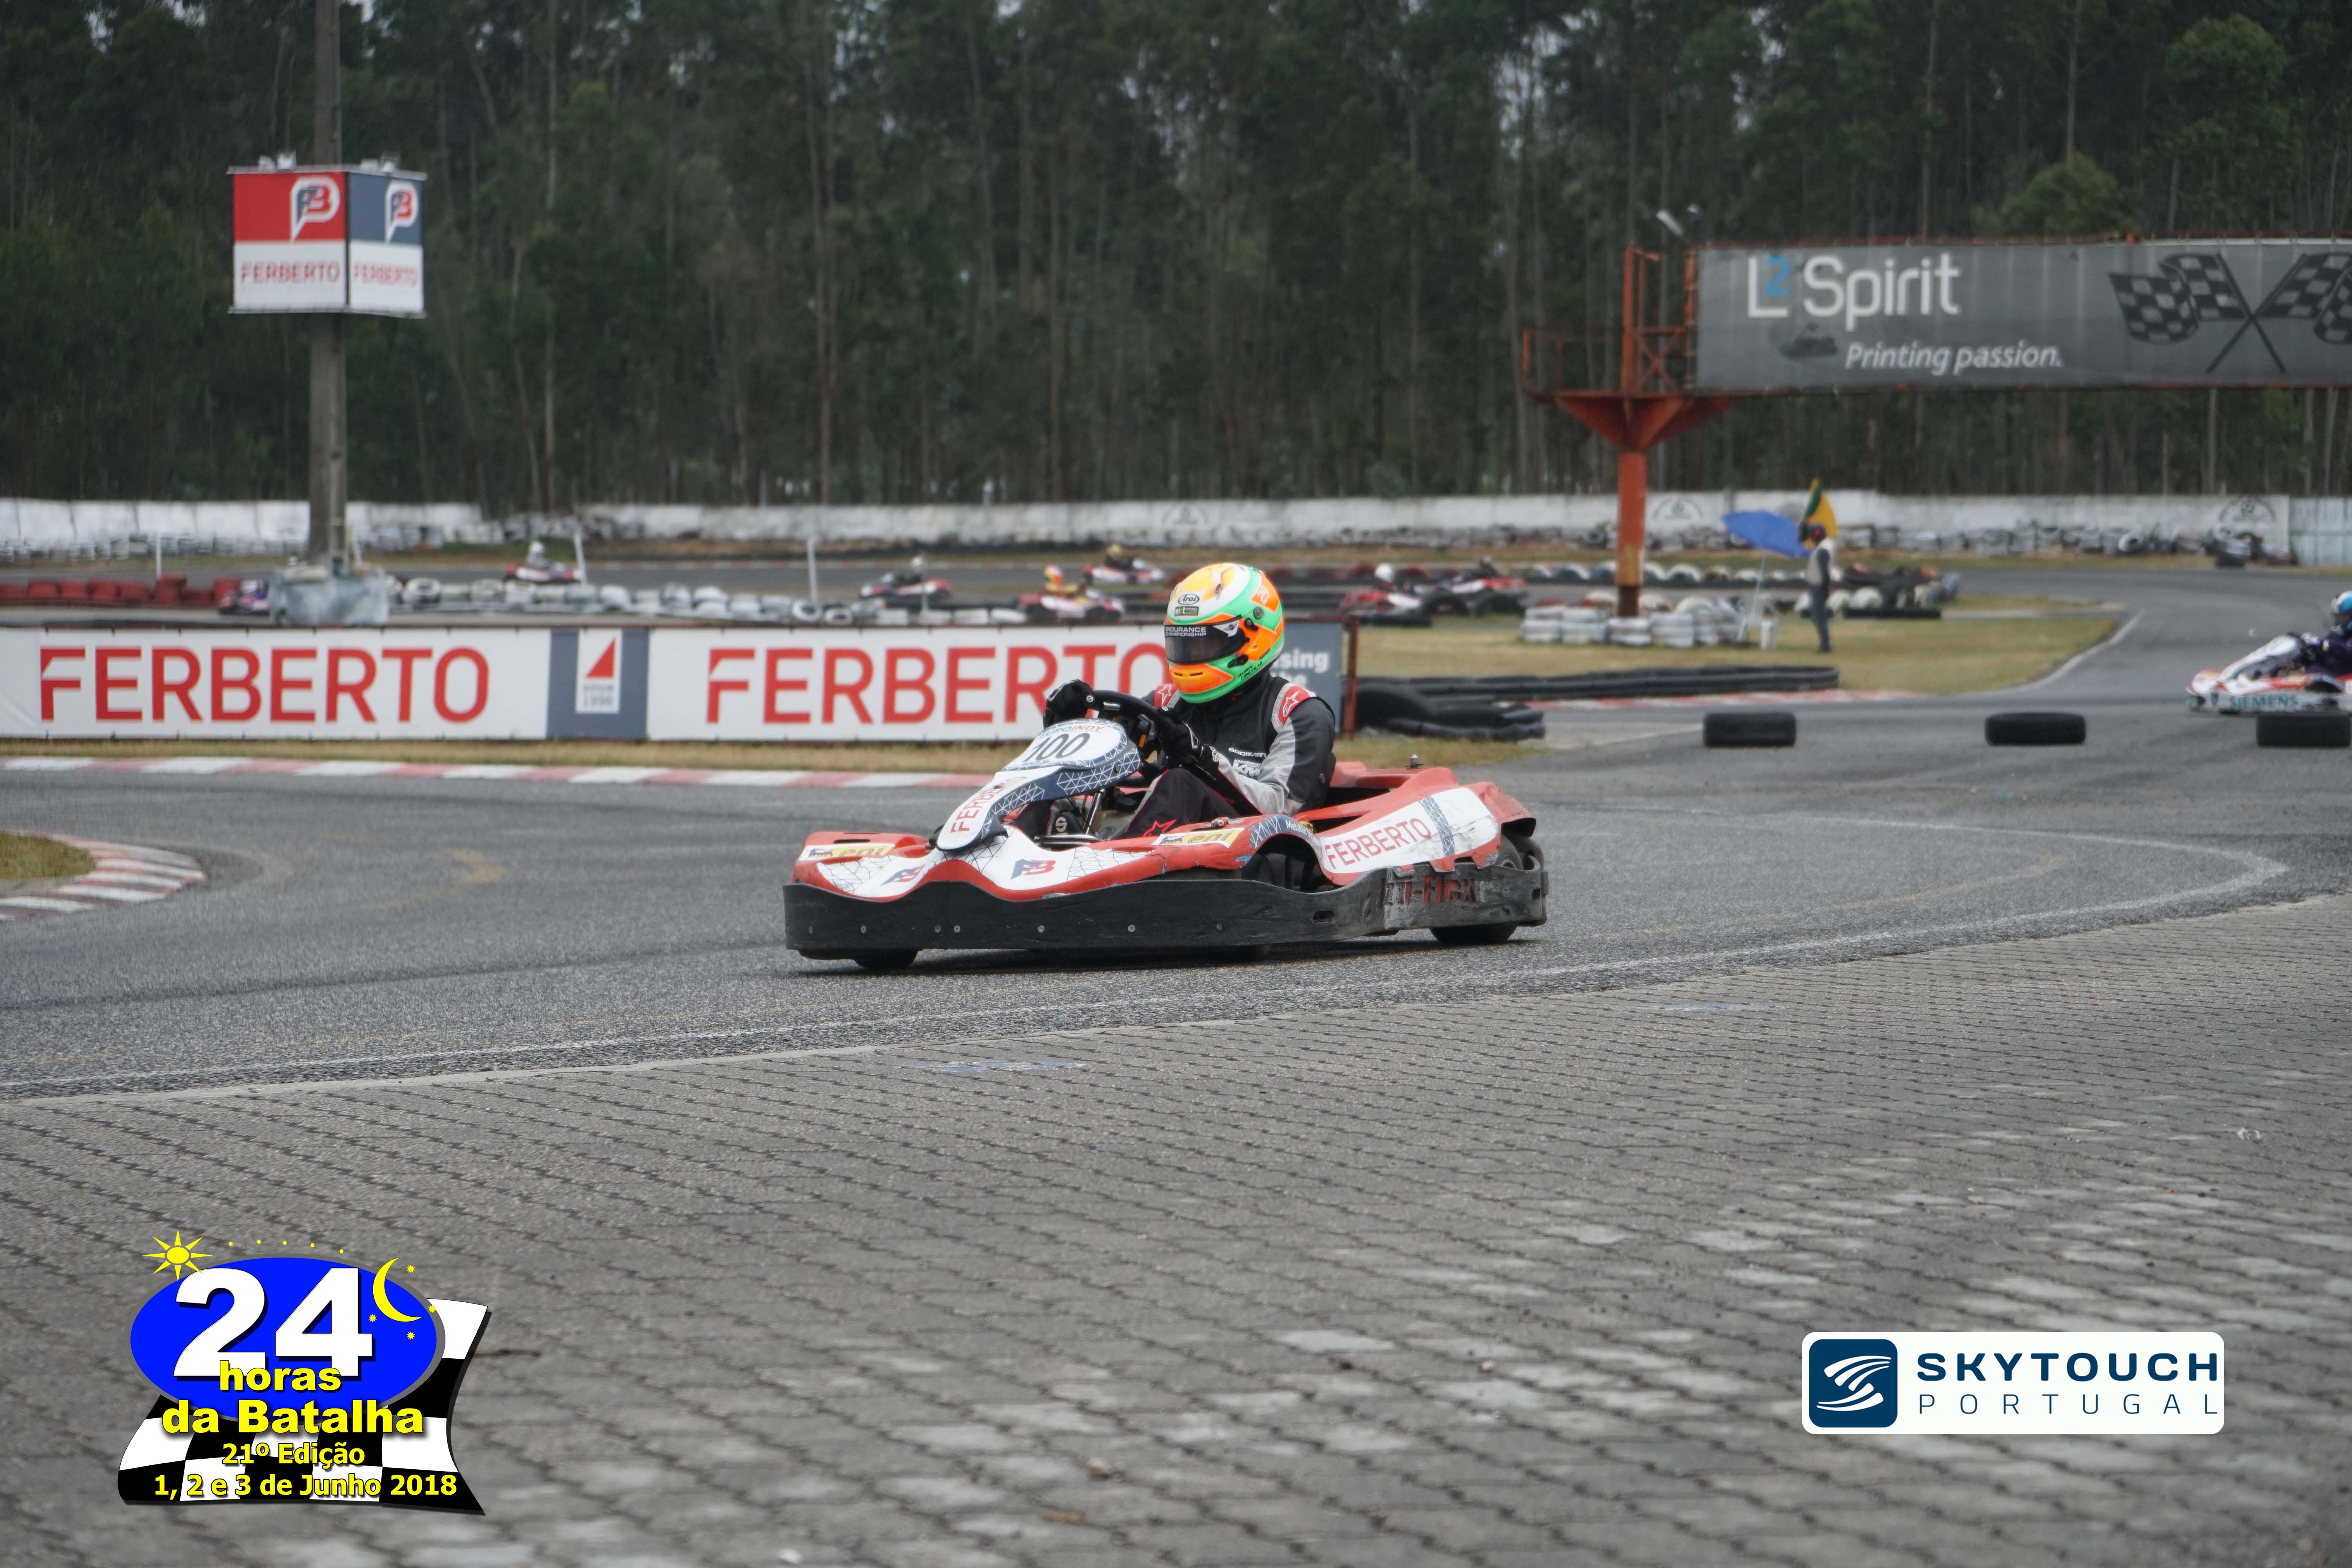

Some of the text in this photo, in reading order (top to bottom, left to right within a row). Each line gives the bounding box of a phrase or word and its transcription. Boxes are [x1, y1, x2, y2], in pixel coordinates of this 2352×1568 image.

[241, 260, 340, 284] FERBERTO
[354, 260, 418, 288] FERBERTO
[1844, 339, 2063, 376] Printing passion.
[40, 646, 489, 724] FERBERTO
[707, 643, 1170, 724] FERBERTO
[2229, 694, 2299, 706] SIEMENS
[1040, 725, 1103, 739] EUROINDY
[1022, 733, 1090, 762] 100
[1325, 818, 1431, 869] FERBERTO
